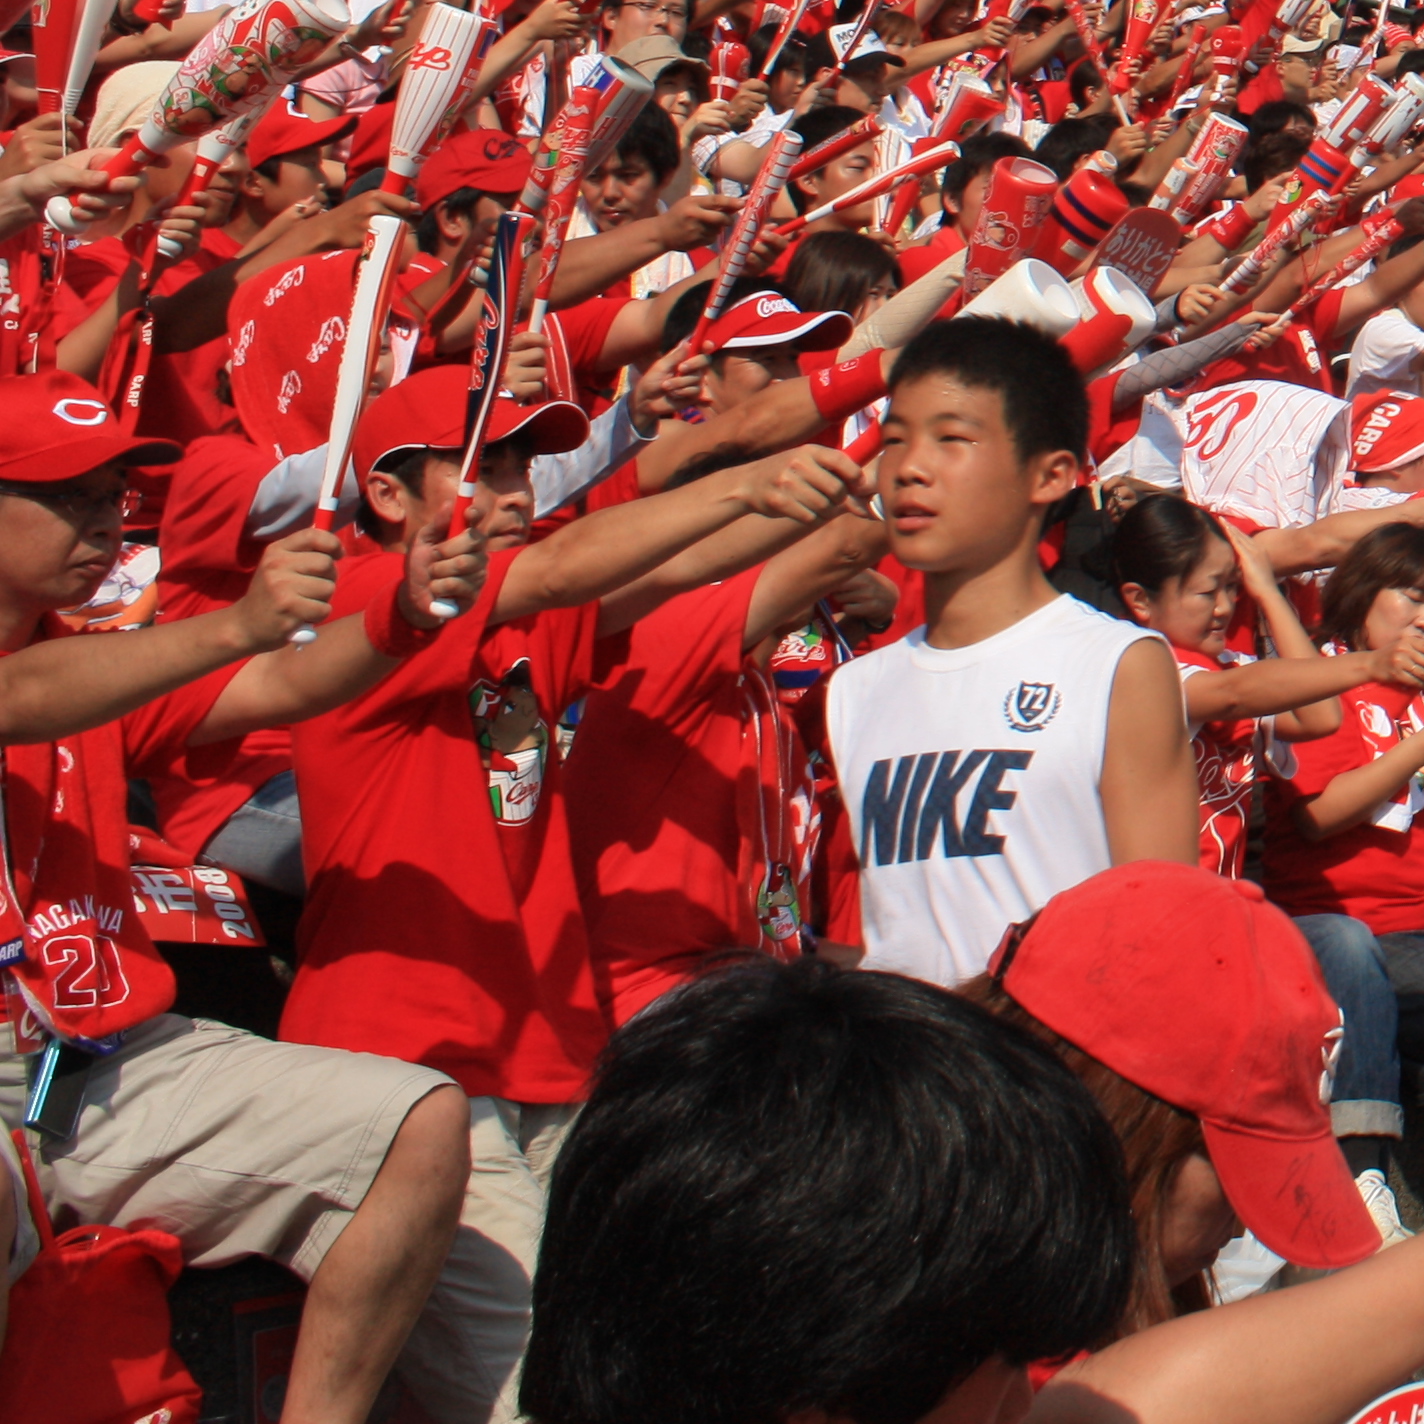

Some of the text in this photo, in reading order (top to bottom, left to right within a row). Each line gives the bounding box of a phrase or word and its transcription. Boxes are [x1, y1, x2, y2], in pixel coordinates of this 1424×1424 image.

[126, 374, 146, 408] CARP
[1353, 401, 1401, 456] CARP
[1022, 683, 1048, 710] 72
[860, 748, 1035, 867] NIKE
[193, 867, 256, 940] 2008
